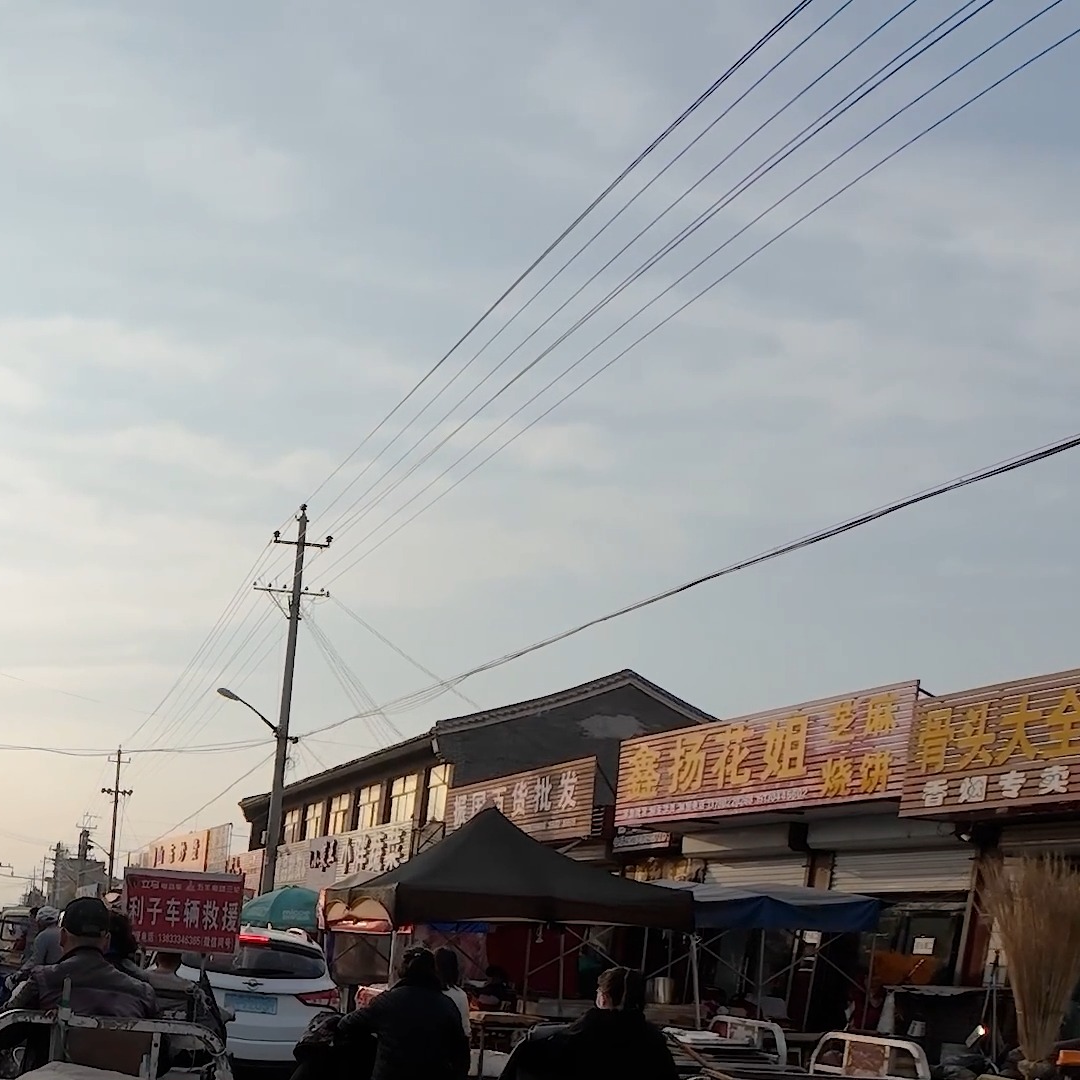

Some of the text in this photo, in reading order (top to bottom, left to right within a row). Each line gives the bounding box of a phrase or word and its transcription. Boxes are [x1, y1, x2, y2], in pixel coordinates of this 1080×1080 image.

[826, 692, 901, 742] 芝麻
[919, 687, 1080, 773] 骨头大全
[627, 714, 809, 800] 鑫扬花姐
[821, 751, 894, 798] 烧饼
[128, 895, 239, 932] 利子车辆救援
